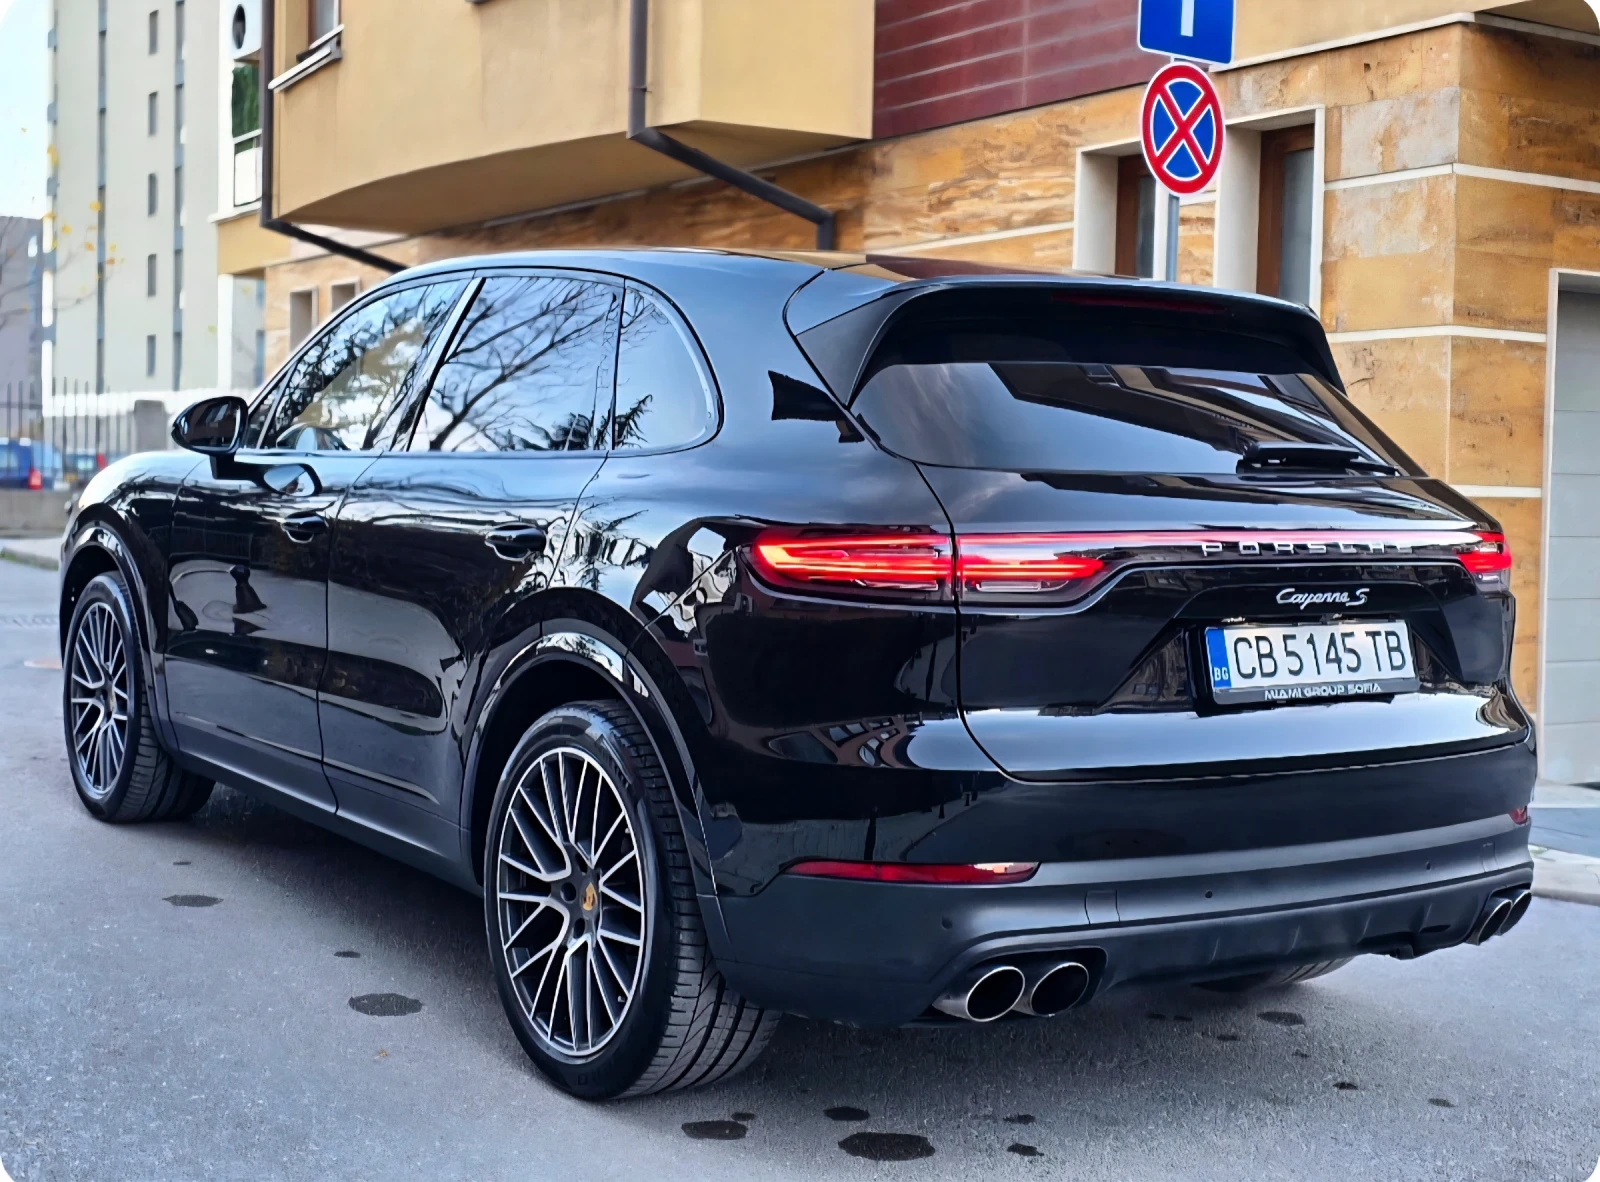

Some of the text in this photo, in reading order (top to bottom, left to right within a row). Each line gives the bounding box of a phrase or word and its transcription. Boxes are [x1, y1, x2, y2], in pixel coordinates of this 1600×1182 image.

[1276, 588, 1370, 610] Cayenne S
[1233, 630, 1407, 680] CB 5145 TB
[1213, 667, 1229, 681] BG
[1303, 684, 1345, 698] GROUP
[1347, 682, 1383, 695] SOFIA
